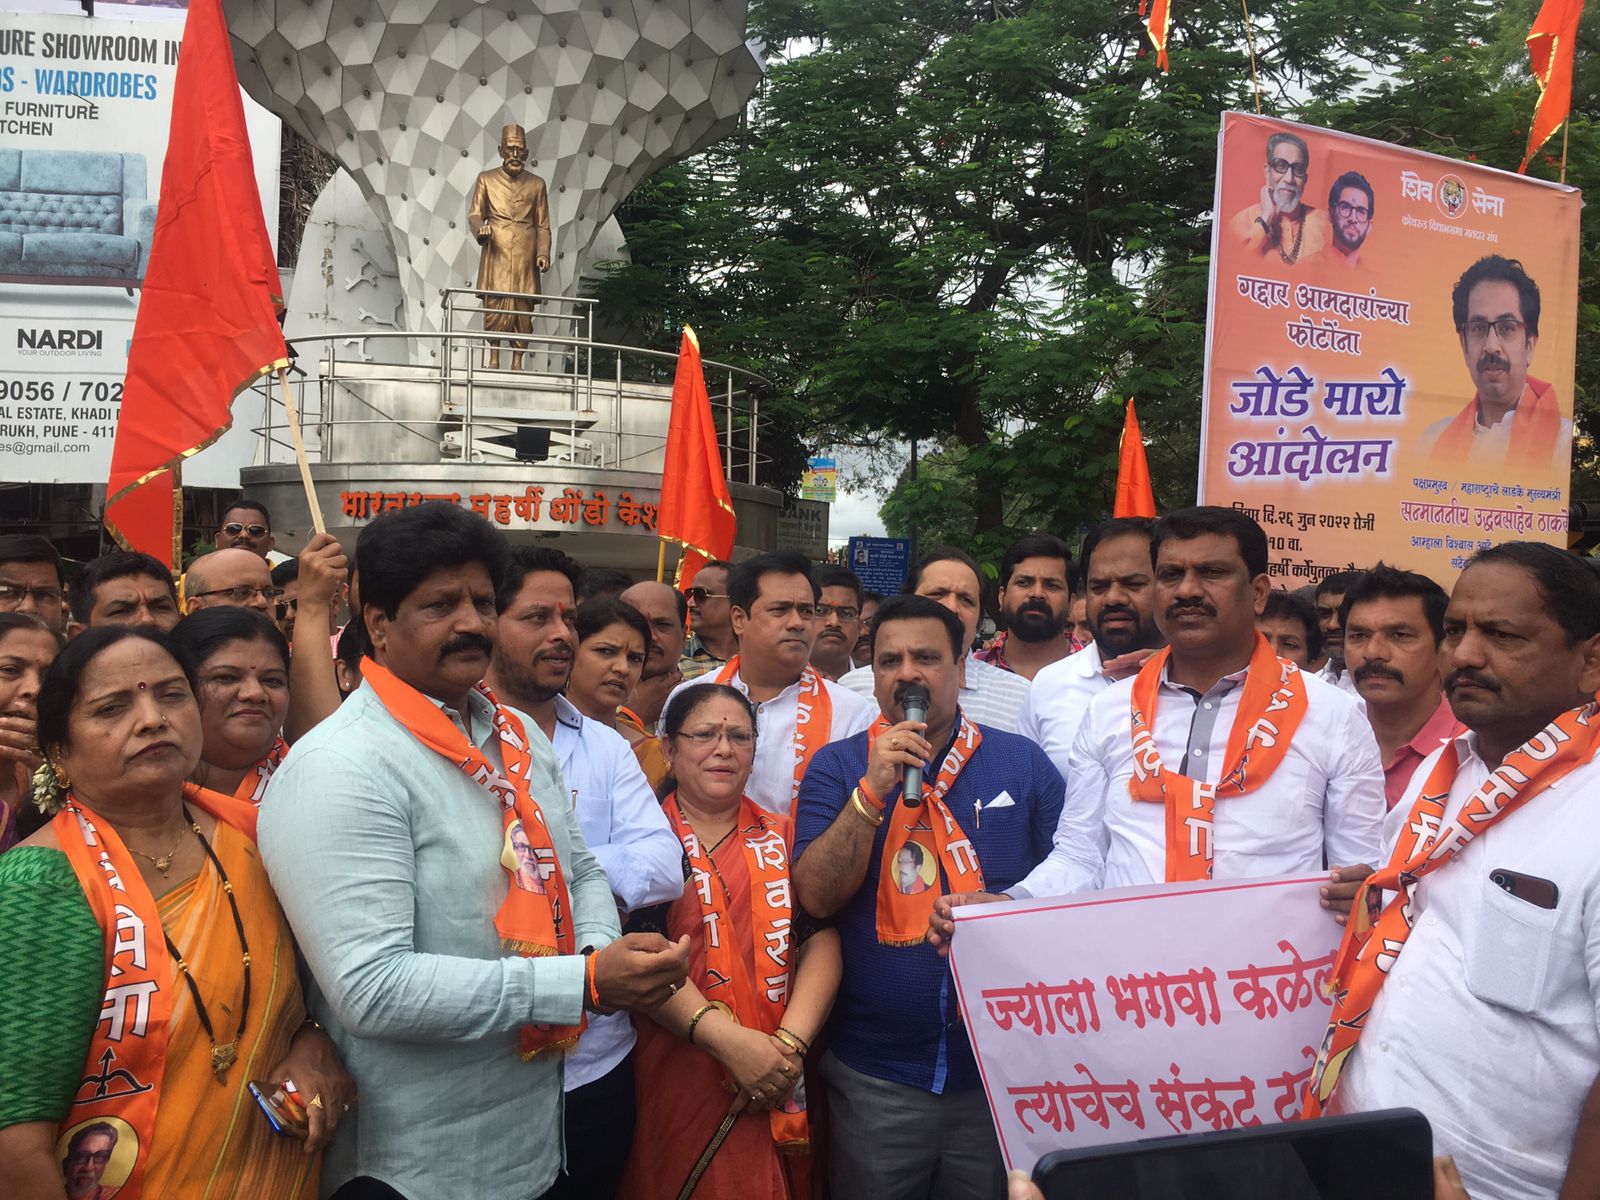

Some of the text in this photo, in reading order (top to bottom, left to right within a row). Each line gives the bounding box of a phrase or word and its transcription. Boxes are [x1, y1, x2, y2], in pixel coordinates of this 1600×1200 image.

[42, 32, 158, 65] SHOWROOM
[0, 66, 15, 93] S
[35, 68, 158, 101] WARDROBES
[5, 101, 100, 121] FURNITURE
[0, 119, 53, 137] TCHEN
[1400, 170, 1505, 218] शिव सेना
[1237, 276, 1410, 325] गद्दार आमदारांच्या
[17, 328, 103, 350] NARDI
[1286, 316, 1362, 355] फोटोंना
[62, 381, 71, 402] /
[1229, 366, 1407, 418] जोडे मारो
[17, 406, 67, 421] ESTATE,
[71, 407, 112, 421] KHADI
[43, 424, 79, 438] PUNE
[91, 425, 115, 438] 411
[1227, 425, 1394, 483] आंदोलन
[1297, 511, 1317, 532] जुन
[1319, 514, 1350, 530] २०२२
[1353, 511, 1375, 531] रोजी
[1401, 497, 1470, 527] सन्माननीय
[981, 977, 1102, 1037] ज्याला
[1106, 966, 1222, 1030] भगवा
[1006, 1062, 1146, 1135] त्याचेच
[1149, 1061, 1264, 1135] संकट
